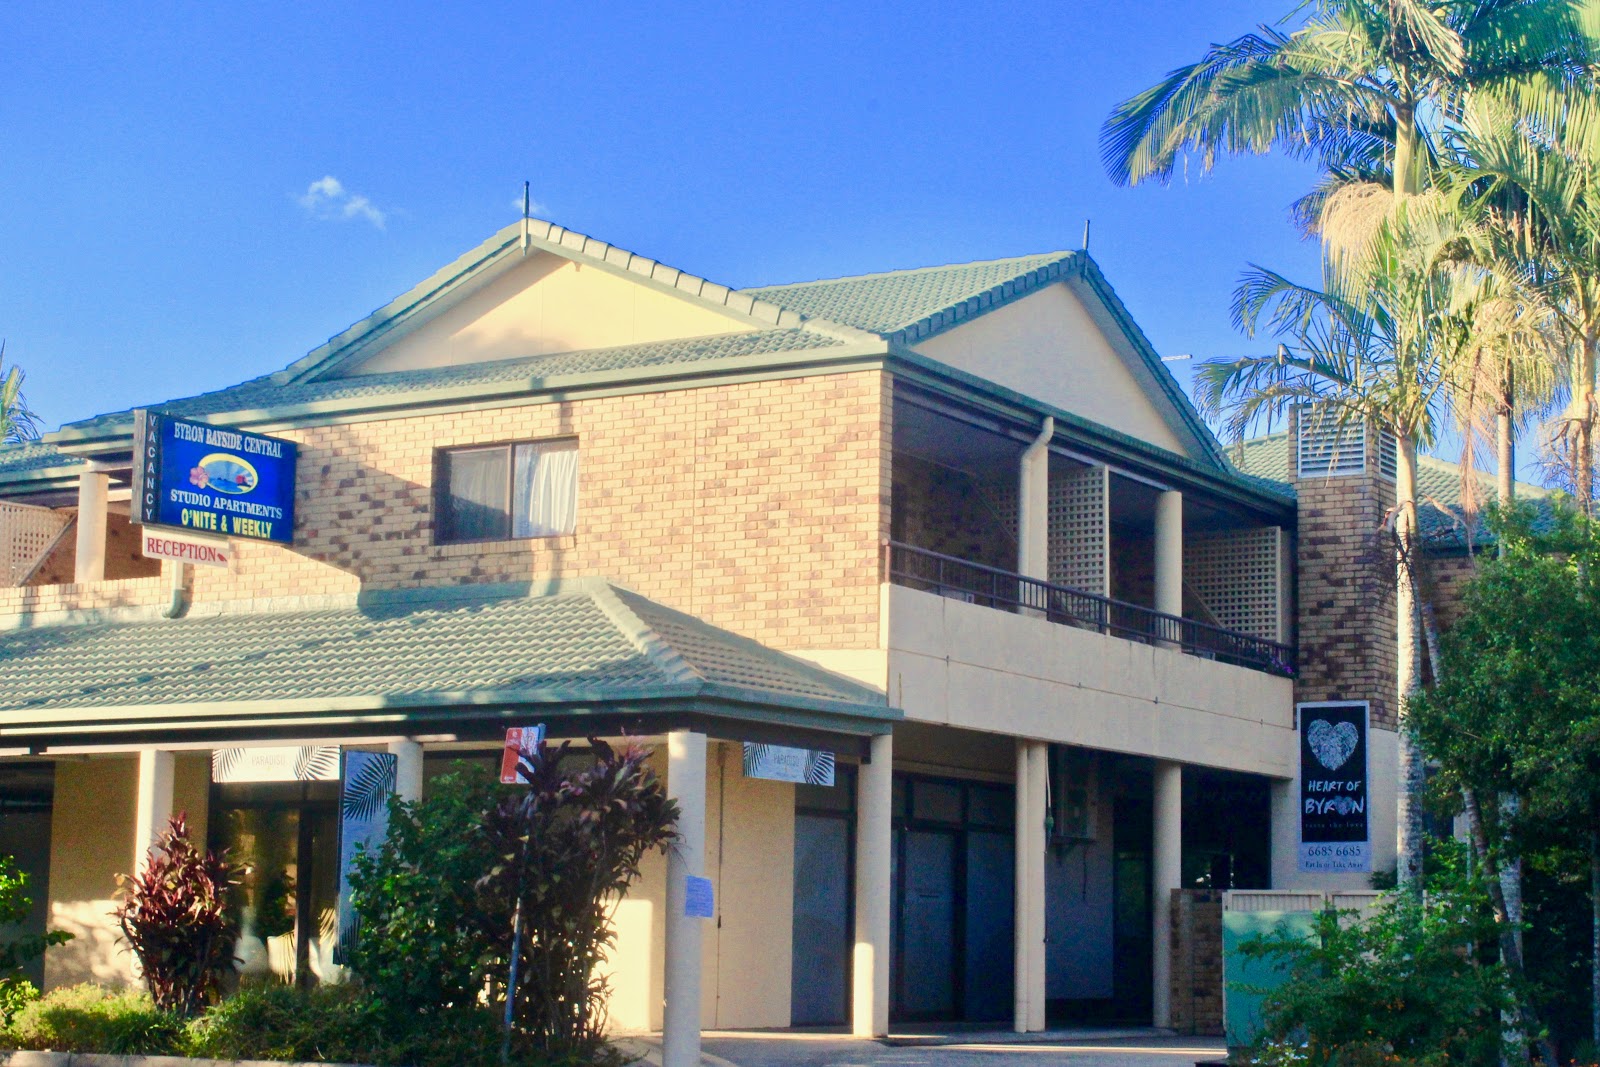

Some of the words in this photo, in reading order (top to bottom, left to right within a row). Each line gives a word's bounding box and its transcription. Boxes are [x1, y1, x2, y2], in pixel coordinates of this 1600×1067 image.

[174, 422, 205, 443] BYRON
[206, 429, 242, 451] BAYSIDE
[244, 436, 282, 458] CENTRAL
[146, 415, 157, 520] VACANCY
[170, 489, 211, 508] STUDIO
[213, 497, 282, 519] APARTMENTS
[181, 508, 217, 530] O'NITE
[221, 515, 228, 532] &
[233, 516, 273, 538] WEEKLY
[147, 537, 217, 562] RECEPTION
[1308, 780, 1344, 792] HEART
[1346, 780, 1361, 791] OF
[1308, 845, 1333, 856] 6685
[1336, 845, 1361, 856] 6685
[1348, 861, 1363, 869] Away
